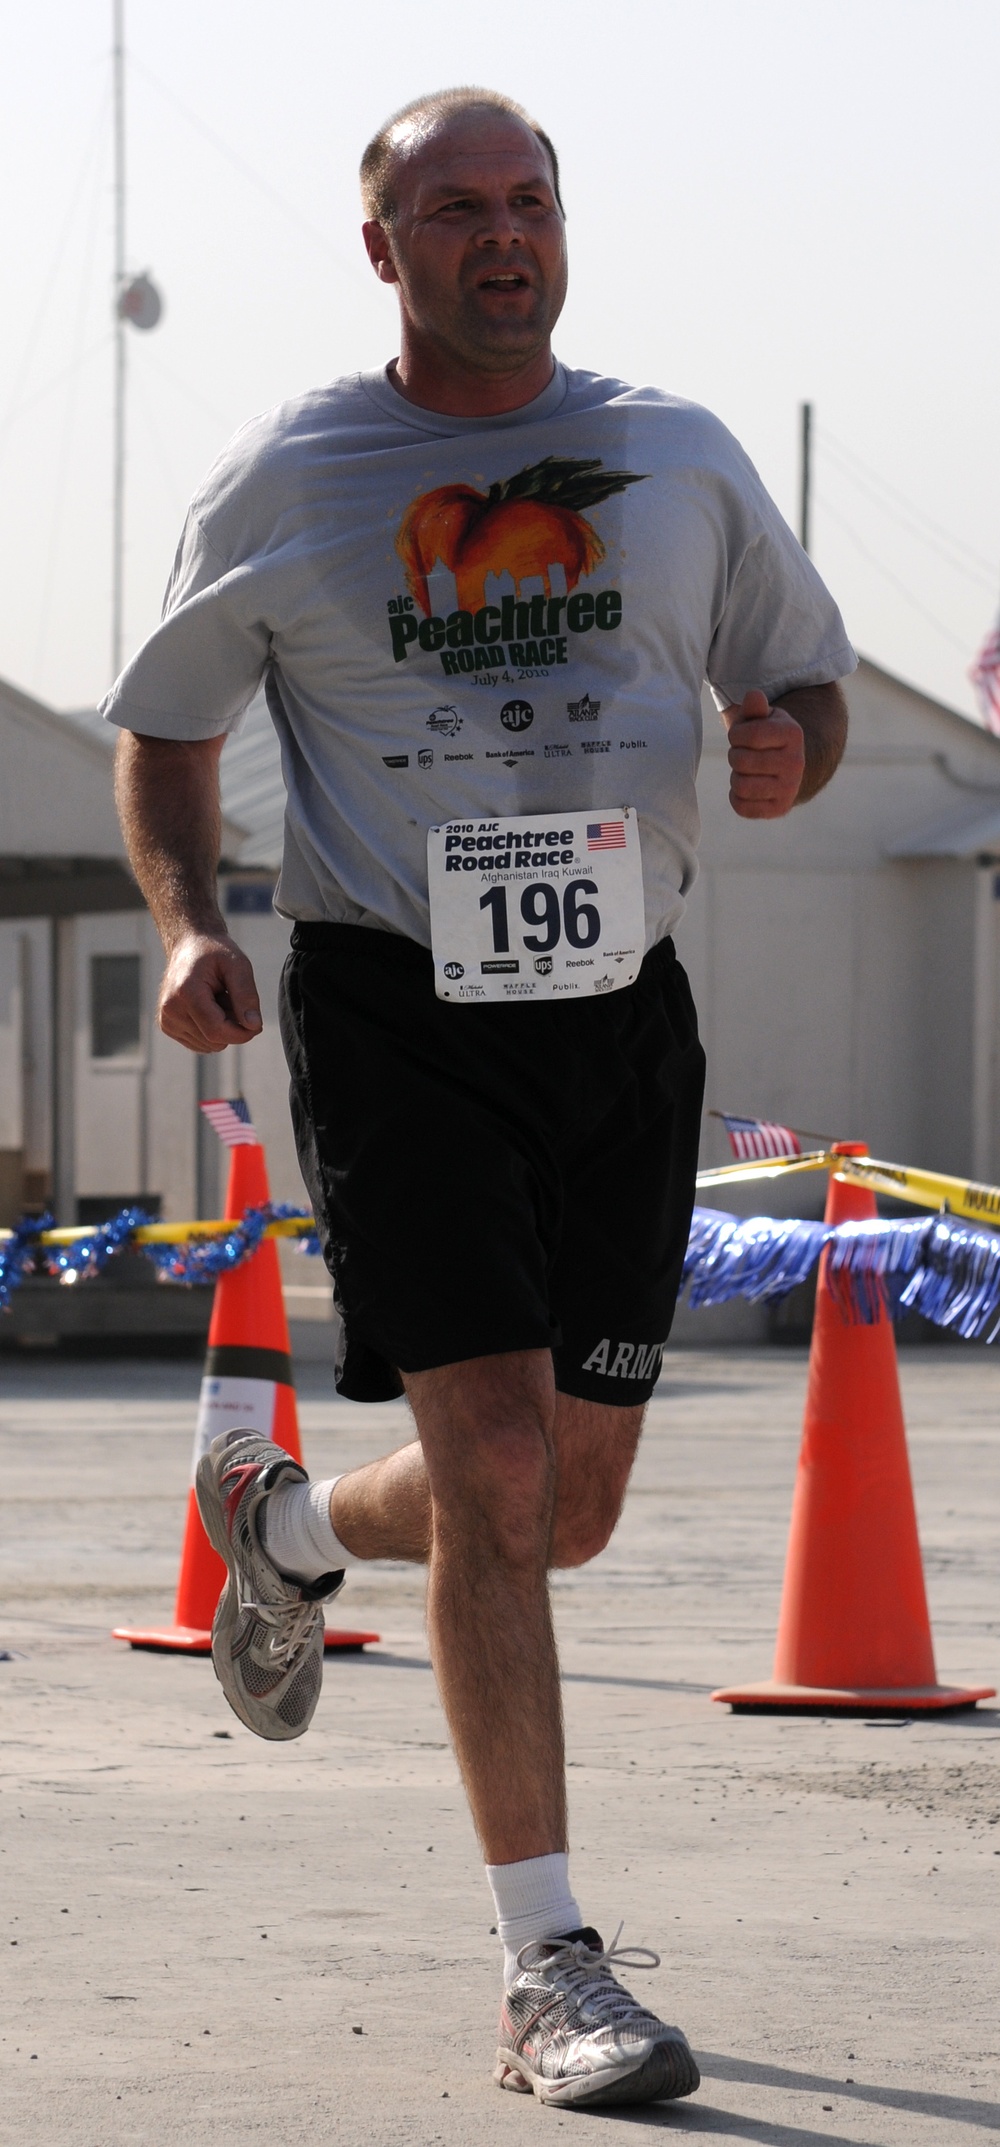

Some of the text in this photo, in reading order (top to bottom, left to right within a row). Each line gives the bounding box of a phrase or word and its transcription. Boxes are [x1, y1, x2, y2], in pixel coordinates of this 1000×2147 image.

[387, 595, 414, 615] ajc
[389, 590, 622, 663] Peachtree
[440, 637, 568, 676] ROAD RACE
[471, 668, 549, 687] July 4, 2010
[502, 704, 533, 728] ajc
[418, 754, 433, 767] ups
[502, 750, 509, 758] of
[509, 748, 535, 757] America
[544, 749, 573, 758] ULTRA
[446, 822, 499, 833] 2010 AJC
[445, 830, 574, 852] Peachtree
[445, 851, 511, 872] Road
[481, 865, 593, 884] Afghanistan Iraq Kuwait
[479, 879, 601, 954] 196
[445, 963, 464, 978] ajc
[535, 960, 553, 974] ups
[565, 959, 595, 968] Reebok
[458, 990, 487, 998] ULTRA
[506, 988, 534, 996] HOUSE
